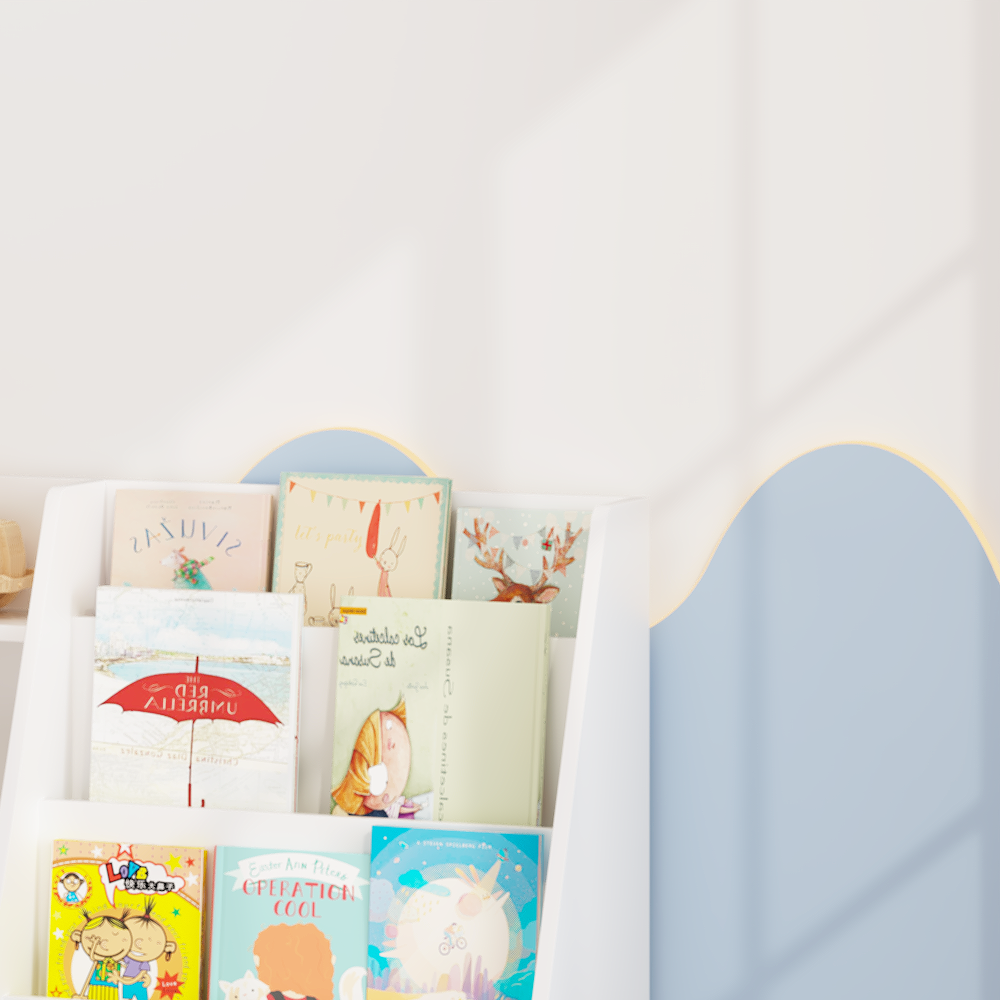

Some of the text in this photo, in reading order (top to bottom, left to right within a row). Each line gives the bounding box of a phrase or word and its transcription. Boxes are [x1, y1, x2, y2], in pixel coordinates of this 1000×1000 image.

[323, 528, 363, 553] party
[242, 878, 355, 902] OPERATION
[273, 899, 322, 918] COOL
